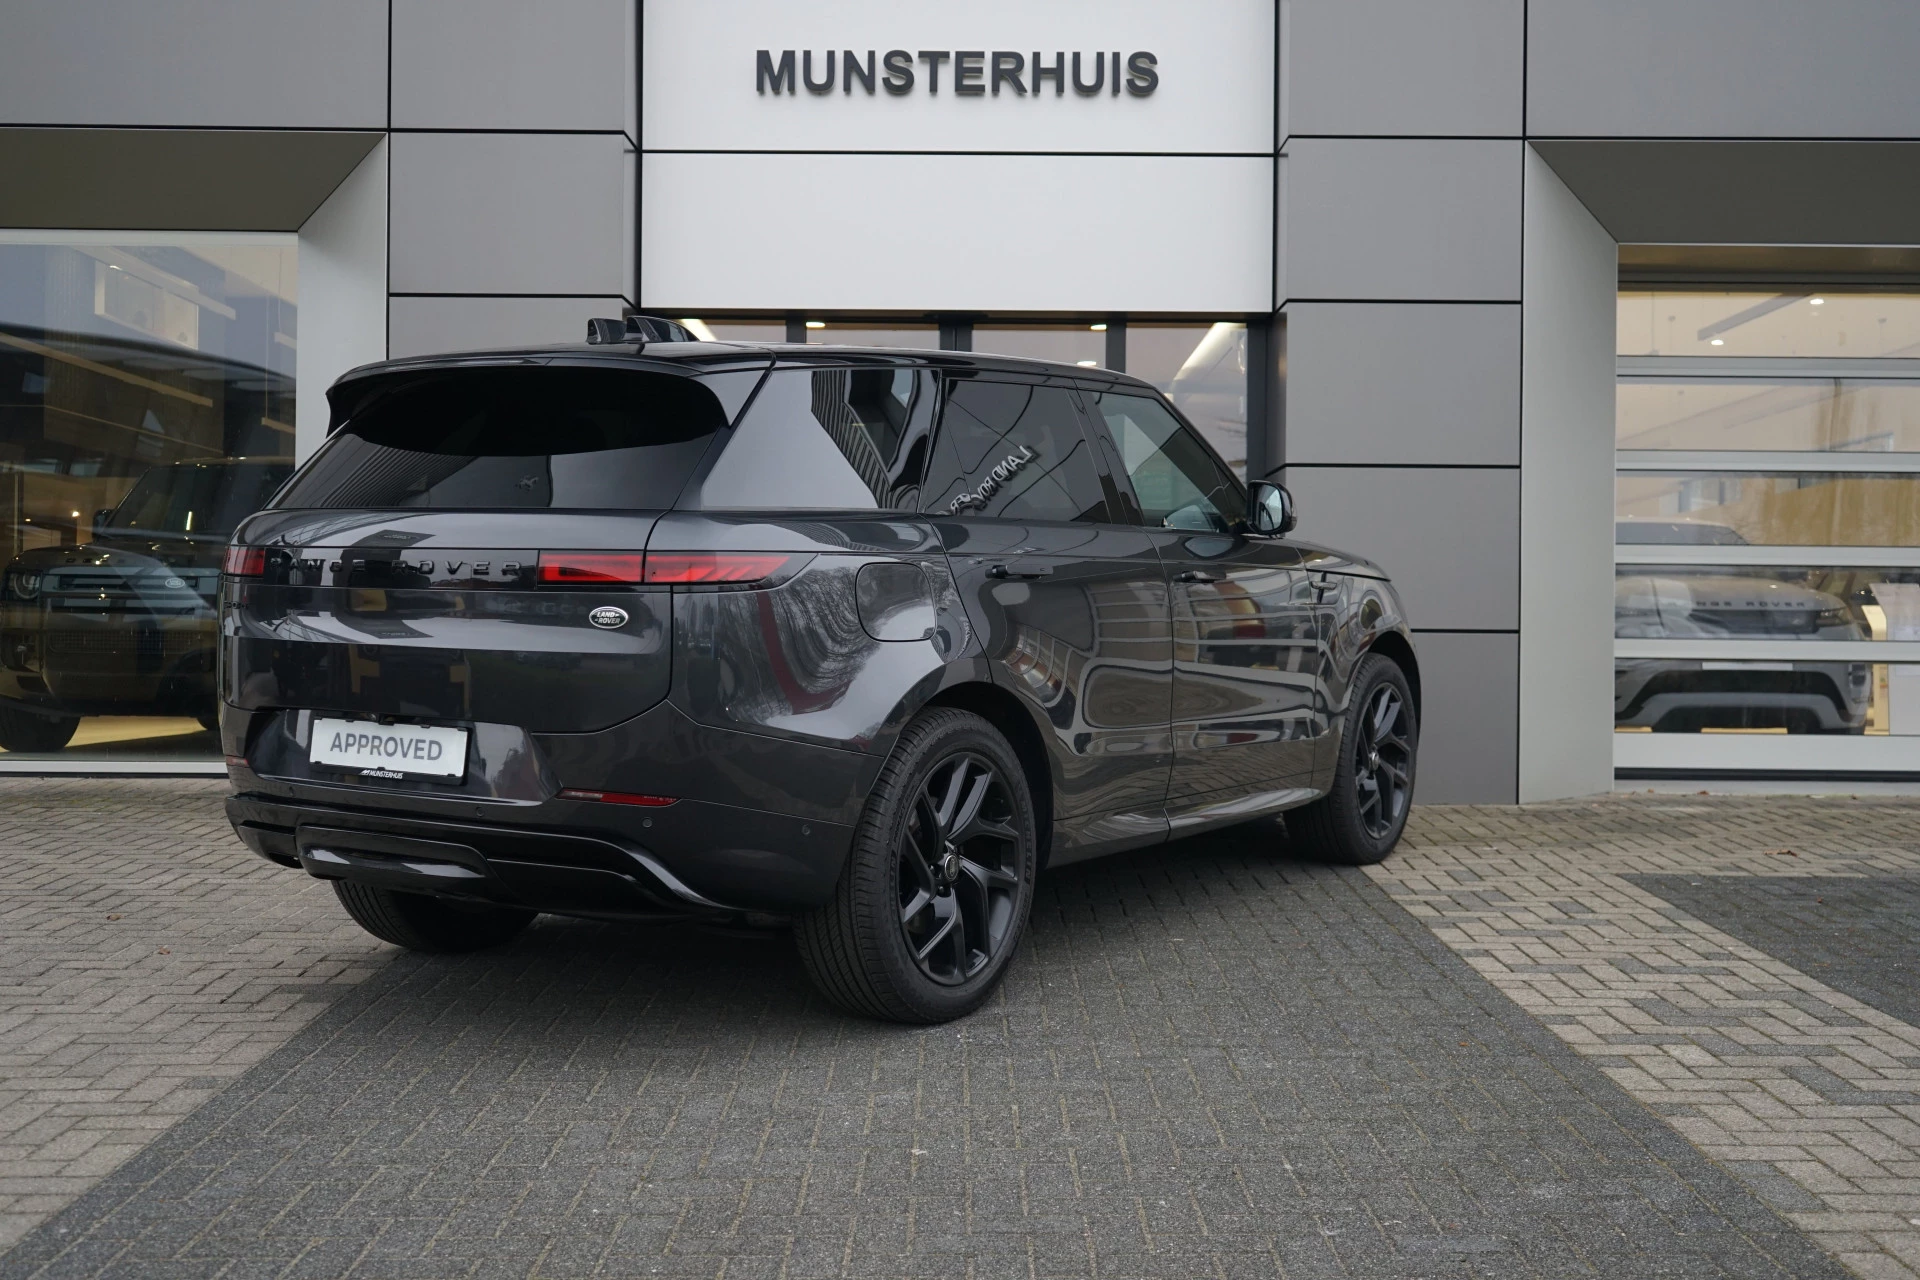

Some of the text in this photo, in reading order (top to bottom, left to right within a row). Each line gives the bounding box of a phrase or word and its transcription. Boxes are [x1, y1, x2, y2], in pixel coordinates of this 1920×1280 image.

[756, 50, 1160, 95] MUNSTERHUIS
[391, 559, 521, 576] ROVER
[330, 731, 443, 761] APPROVED
[369, 769, 404, 780] MUNSTERHUIS
